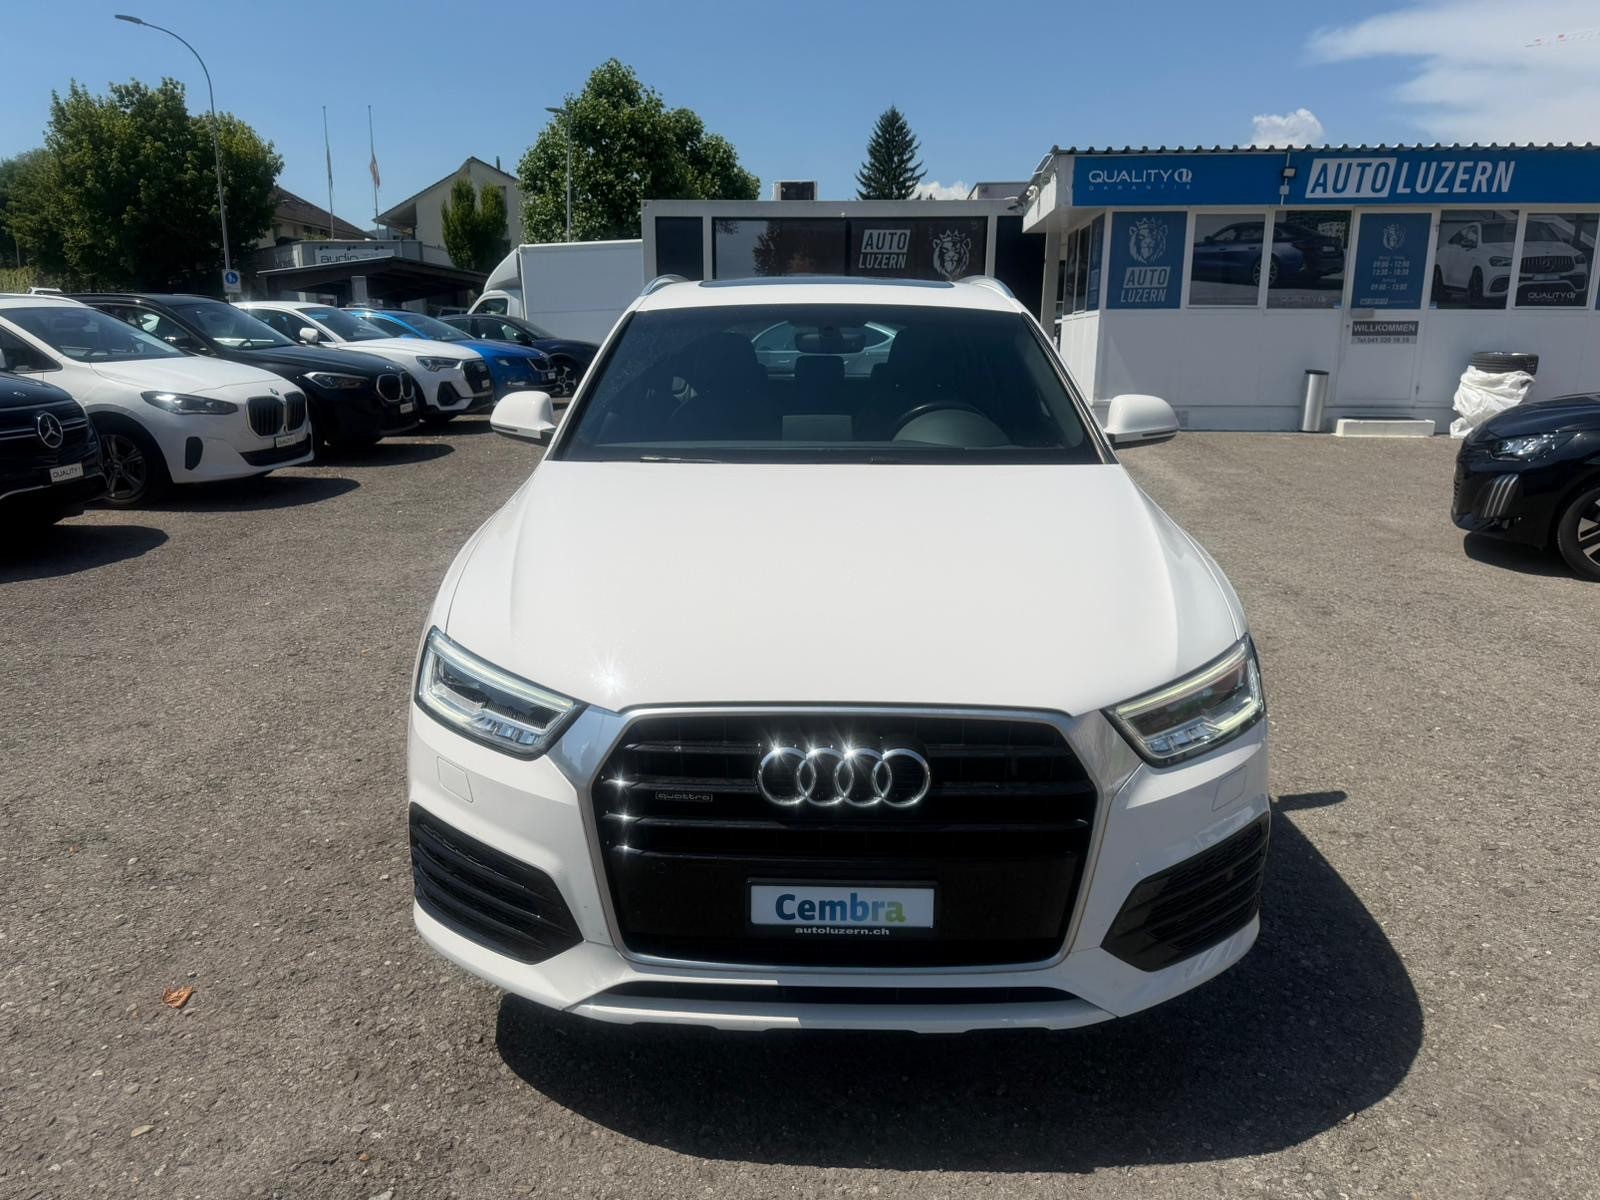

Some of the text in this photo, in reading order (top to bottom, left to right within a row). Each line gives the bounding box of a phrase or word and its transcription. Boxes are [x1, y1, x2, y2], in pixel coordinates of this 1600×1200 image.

[1310, 160, 1516, 194] AUTO LUZERN
[863, 230, 909, 250] AUTO
[858, 253, 908, 270] LUZERN
[1126, 268, 1168, 286] AUTO
[1120, 289, 1167, 303] LUZERN
[1353, 323, 1416, 333] WILLKOMMEN
[657, 793, 710, 801] quattro
[775, 892, 907, 923] Cembra
[794, 926, 890, 936] autoluzern.ch
